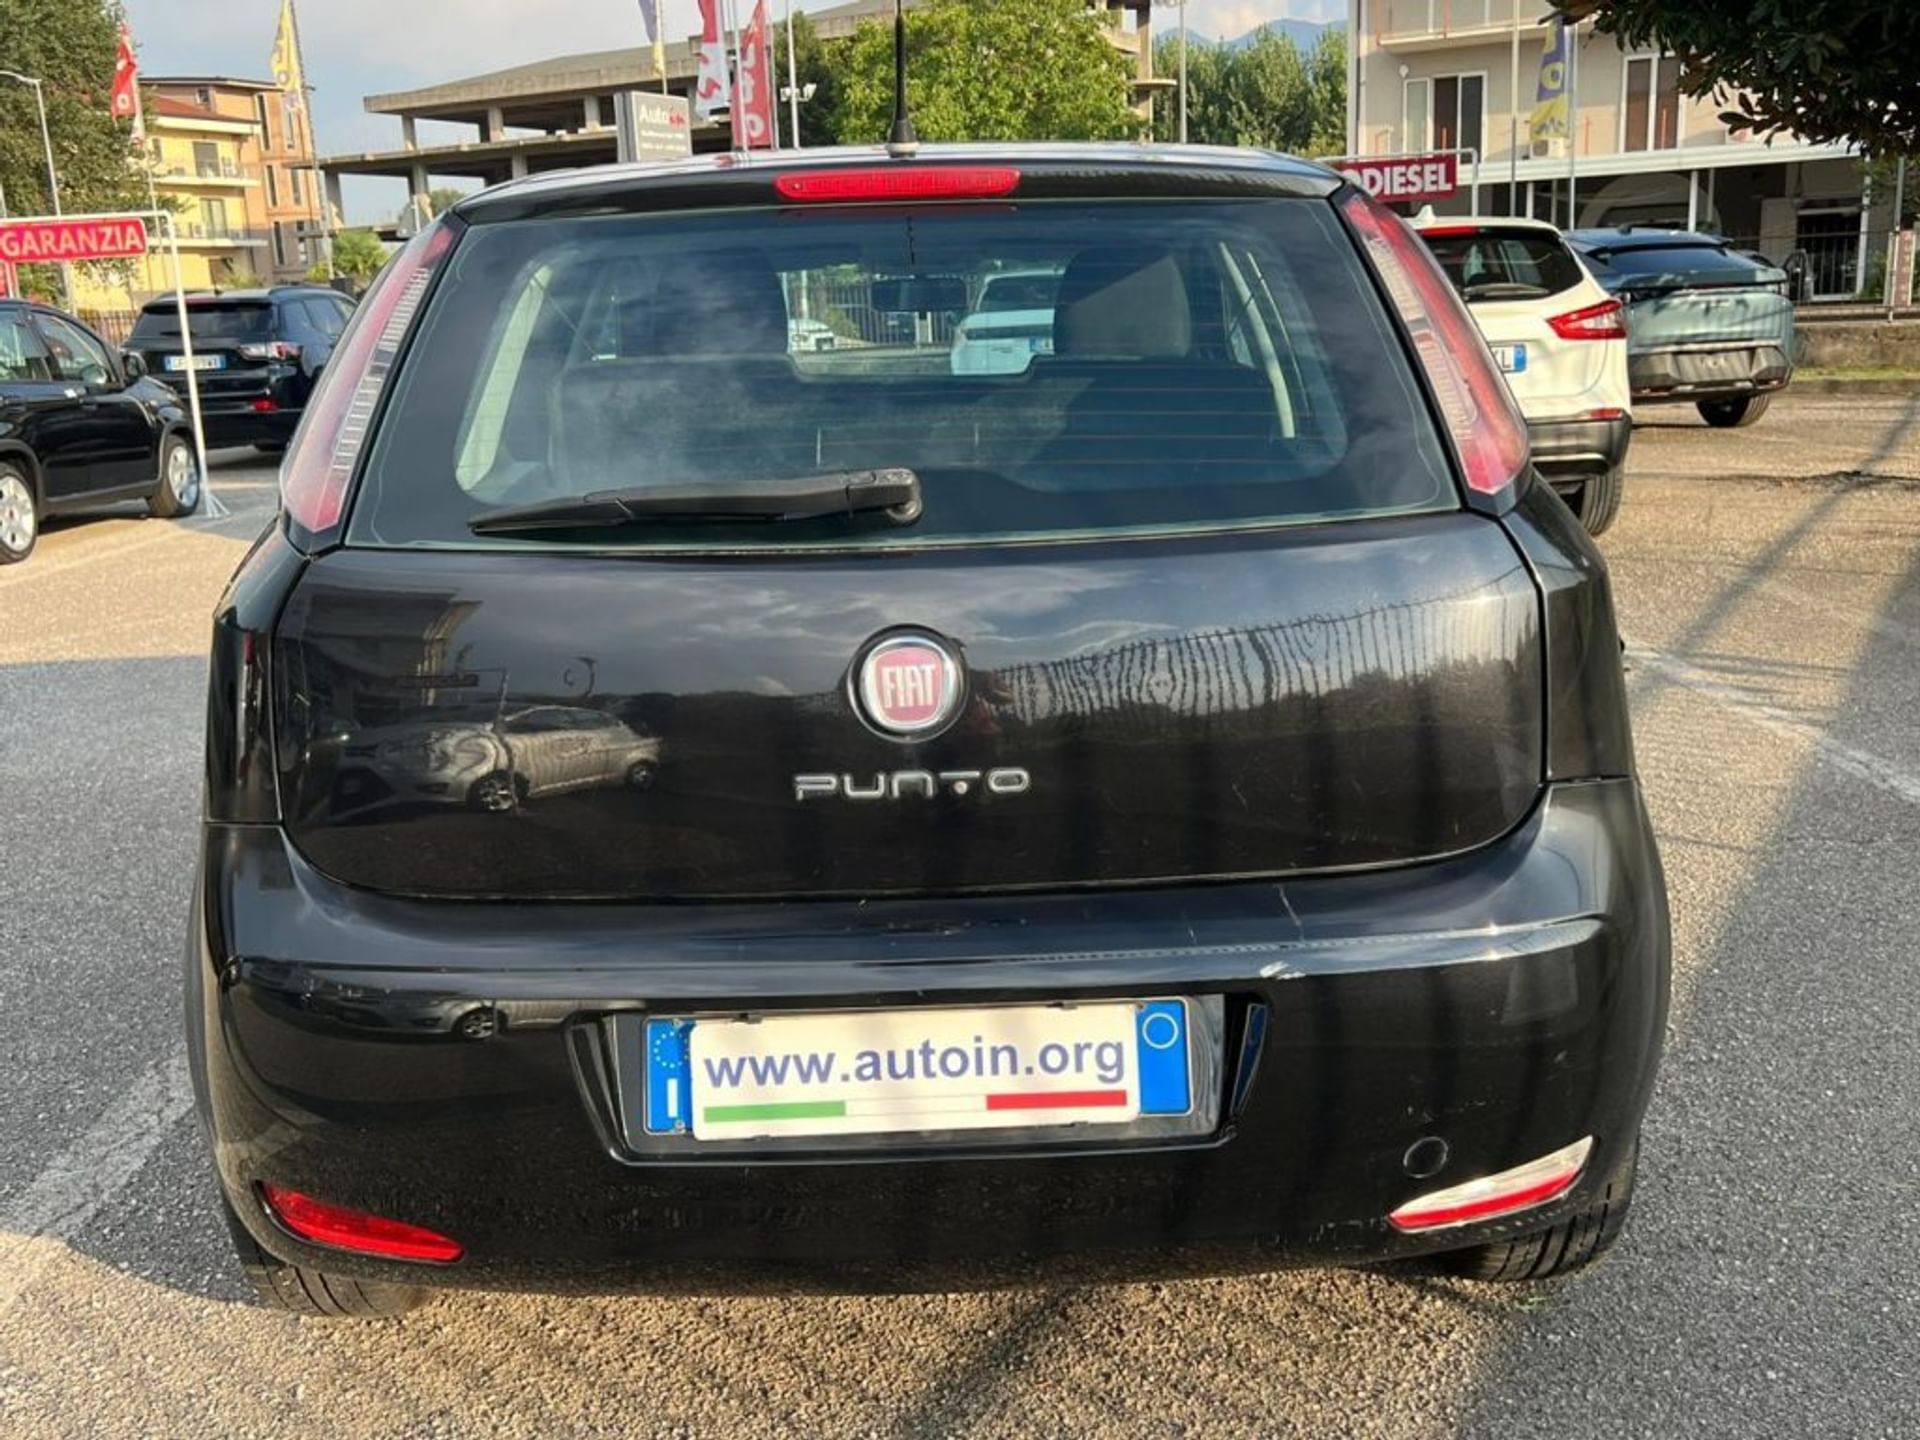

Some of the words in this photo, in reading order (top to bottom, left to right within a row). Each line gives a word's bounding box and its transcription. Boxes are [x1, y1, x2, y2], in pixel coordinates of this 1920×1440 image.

[1, 225, 144, 256] GARANZIA
[881, 664, 935, 708] FIAT
[794, 767, 1029, 801] PUNTO
[703, 1036, 1126, 1085] www.autoin.org
